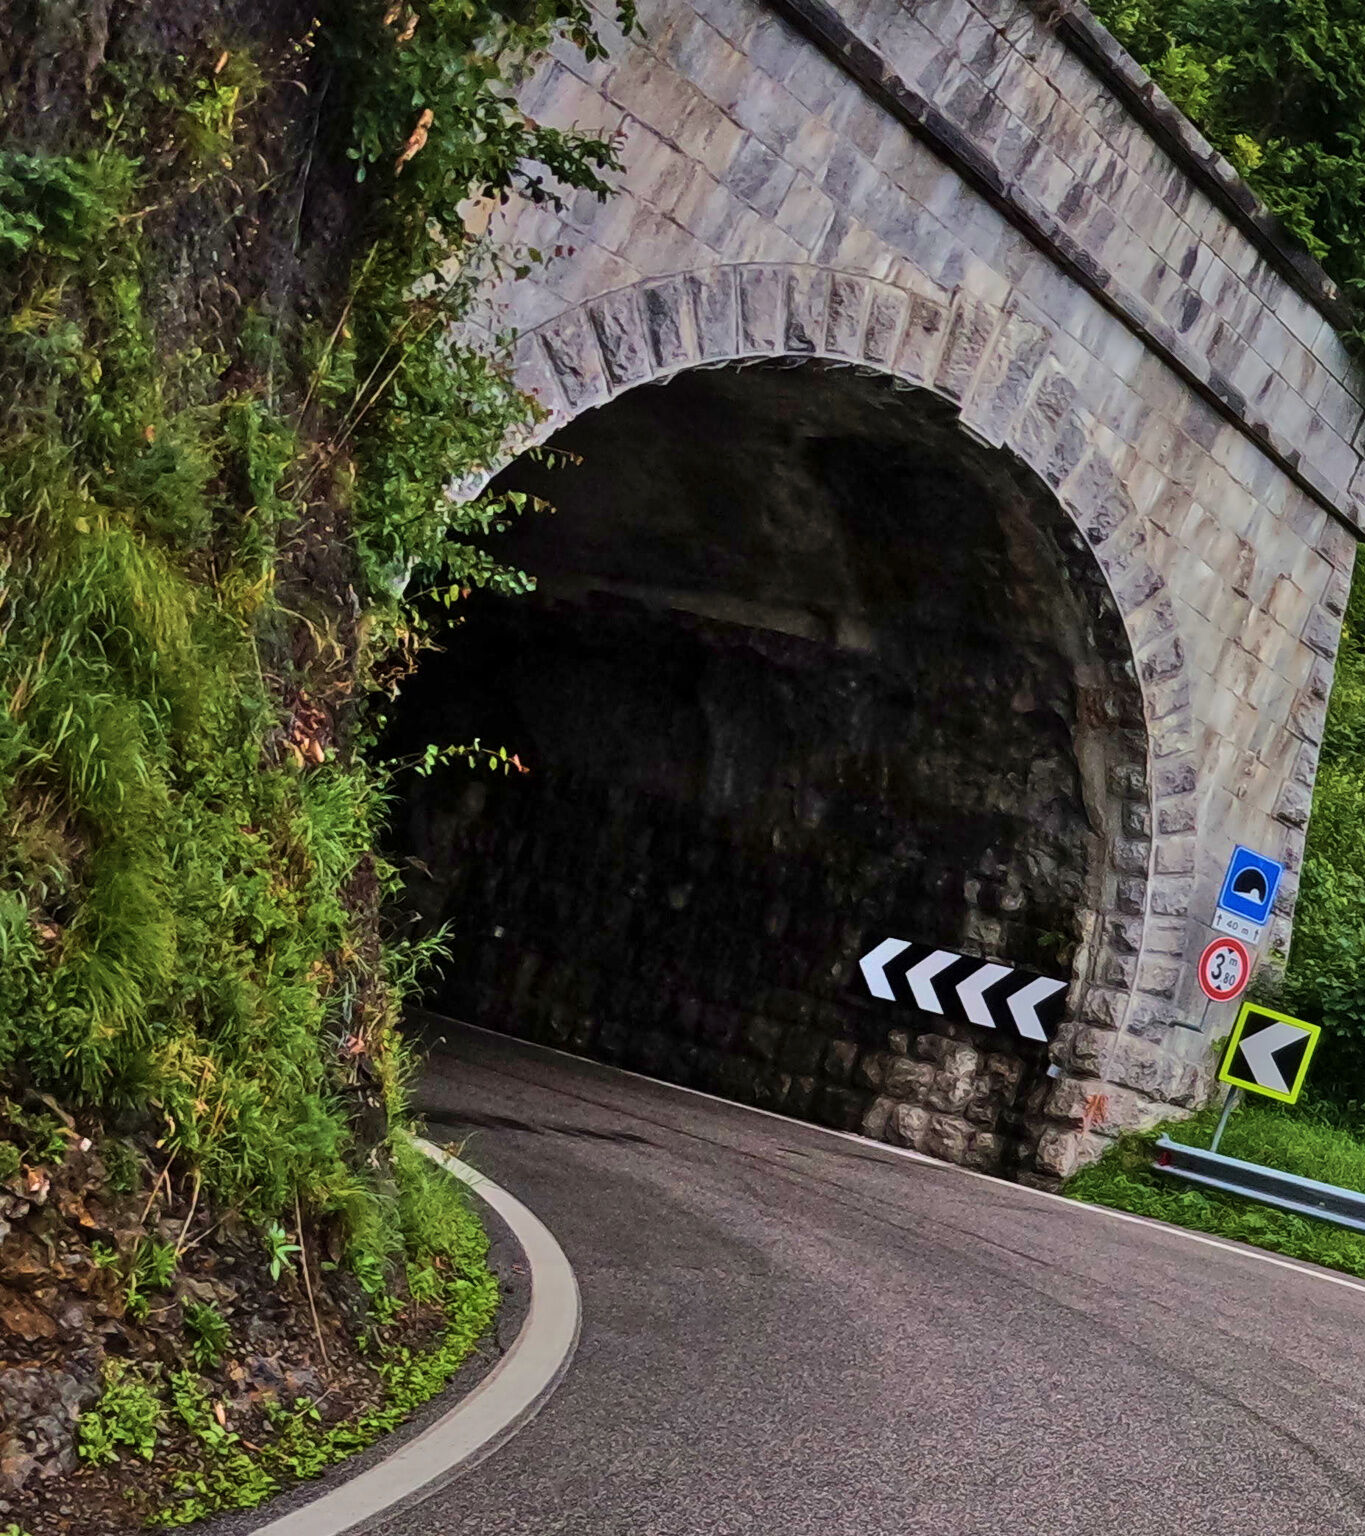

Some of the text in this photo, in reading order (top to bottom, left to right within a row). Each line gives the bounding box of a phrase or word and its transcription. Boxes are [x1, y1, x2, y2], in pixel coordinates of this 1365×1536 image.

[1226, 920, 1249, 935] 40 m
[1211, 953, 1238, 980] 3 m
